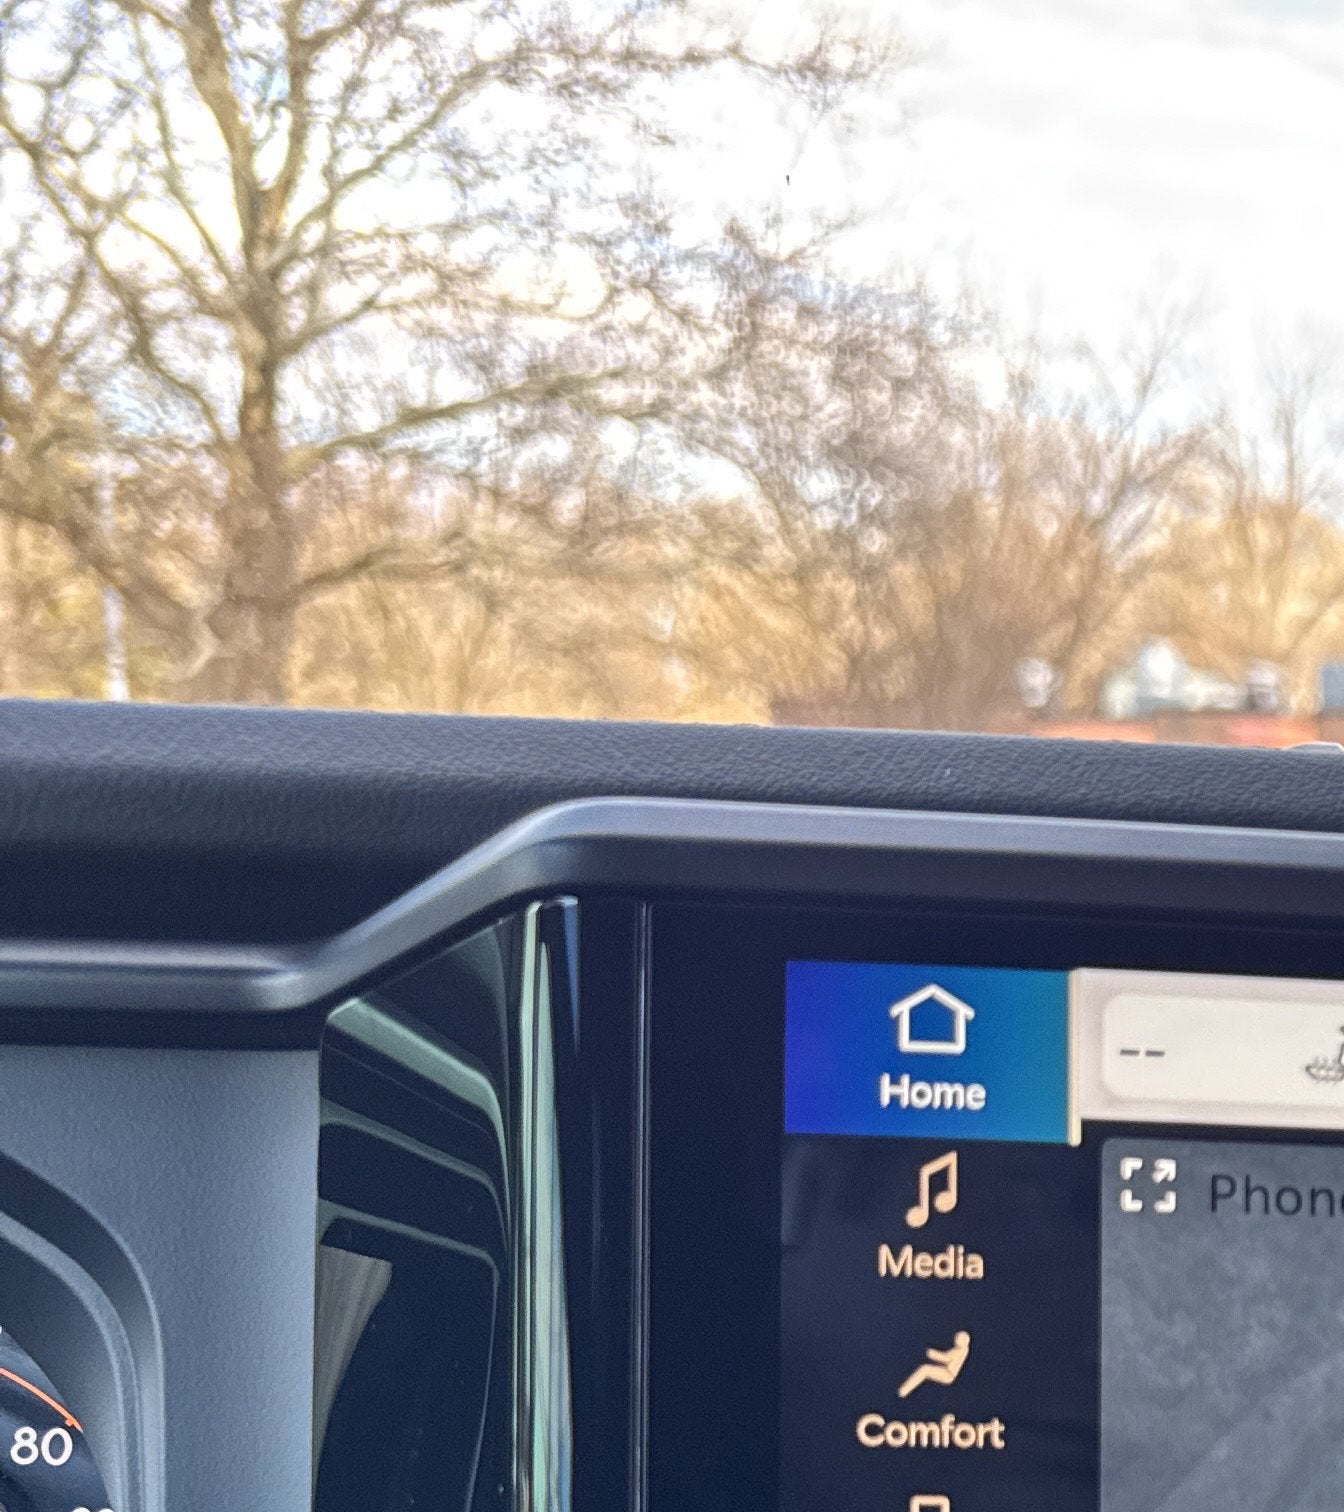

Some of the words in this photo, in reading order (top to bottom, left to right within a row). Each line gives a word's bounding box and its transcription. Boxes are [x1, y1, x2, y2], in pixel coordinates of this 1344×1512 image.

[879, 1073, 986, 1111] Home
[877, 1244, 984, 1280] Media
[10, 1426, 74, 1466] 80
[855, 1413, 1006, 1449] Comfort
